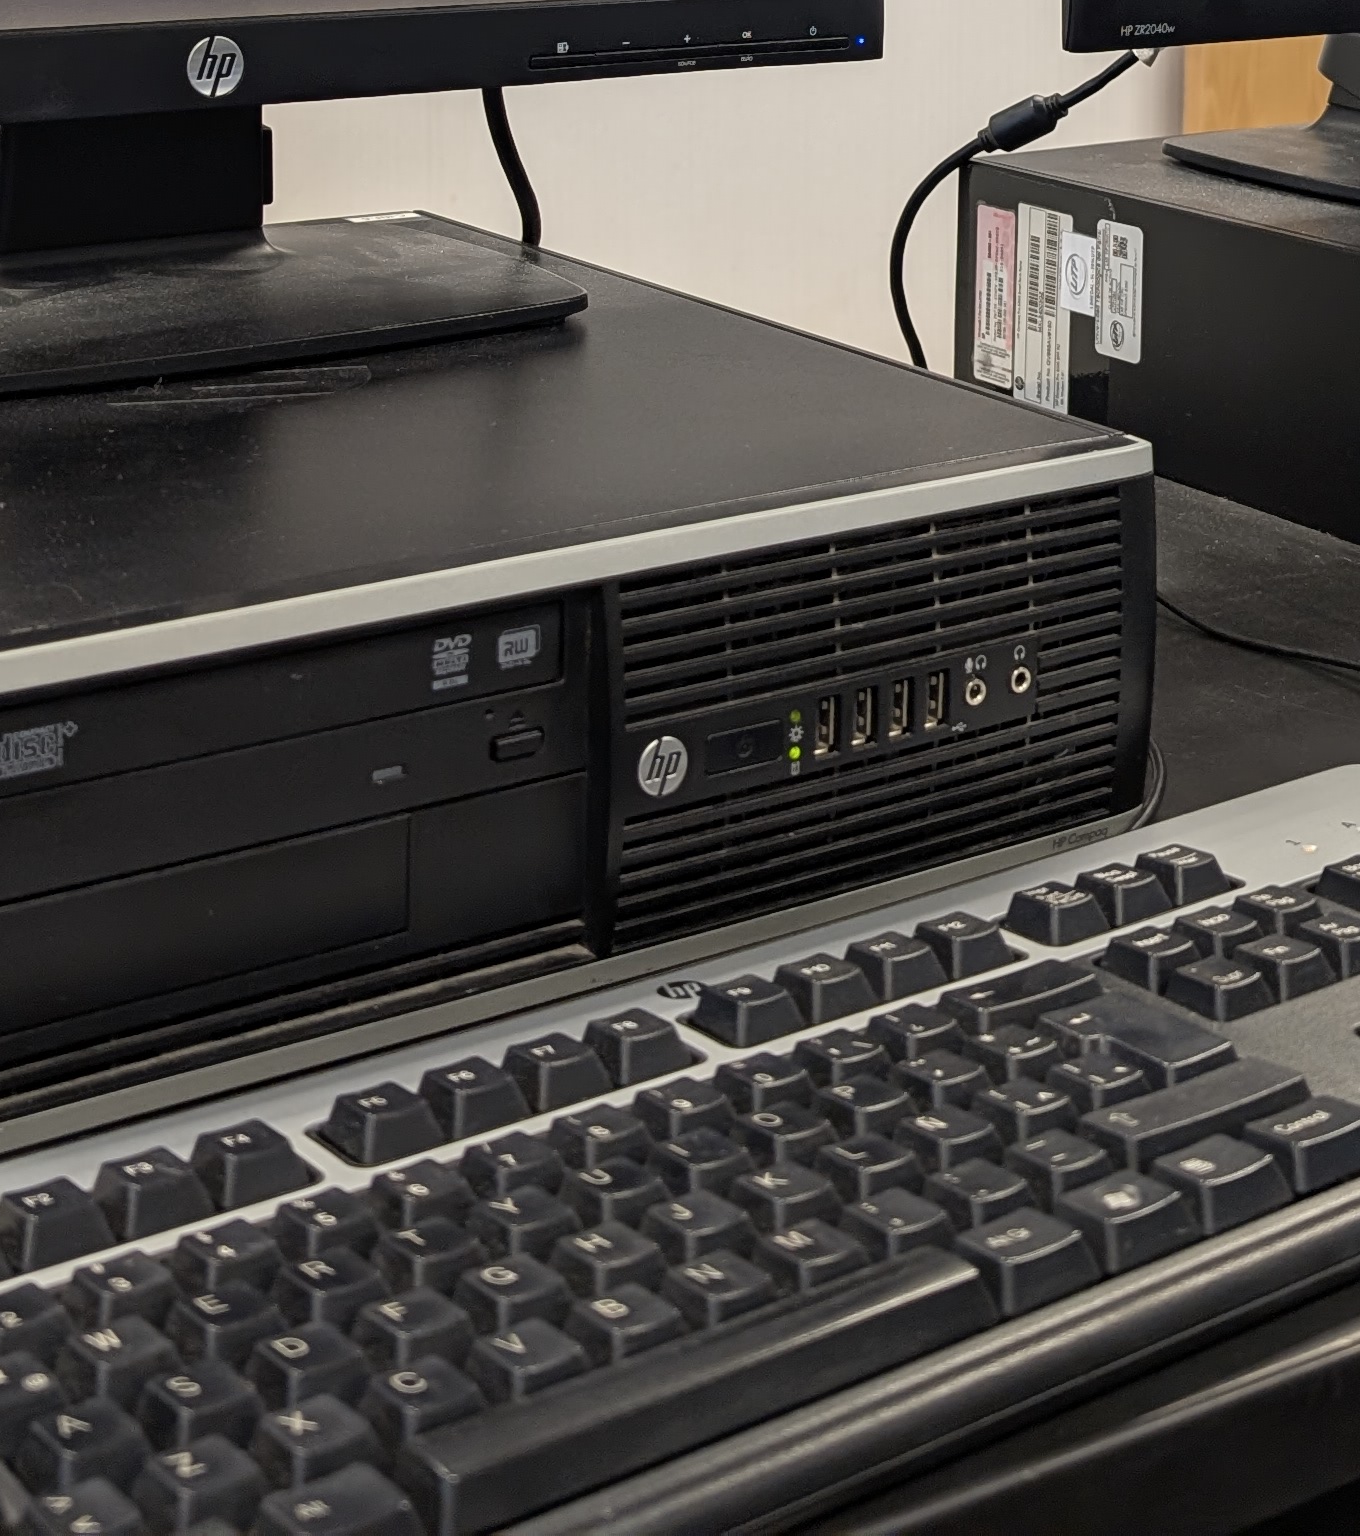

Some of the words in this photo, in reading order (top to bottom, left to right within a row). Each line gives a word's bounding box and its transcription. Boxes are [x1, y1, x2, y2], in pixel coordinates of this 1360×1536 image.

[1120, 24, 1133, 37] HP
[1135, 23, 1175, 36] ZR2040w
[192, 37, 240, 96] hp
[432, 633, 473, 653] DVD
[503, 637, 529, 657] RW
[642, 737, 684, 796] hp
[1052, 836, 1066, 850] HP
[1067, 827, 1109, 846] Compaq
[659, 981, 703, 998] hp
[1273, 1109, 1333, 1135] Control
[22, 1192, 56, 1208] F2
[193, 1294, 232, 1315] E
[270, 1336, 311, 1360] D
[165, 1375, 202, 1398] S
[160, 1450, 208, 1479] Z
